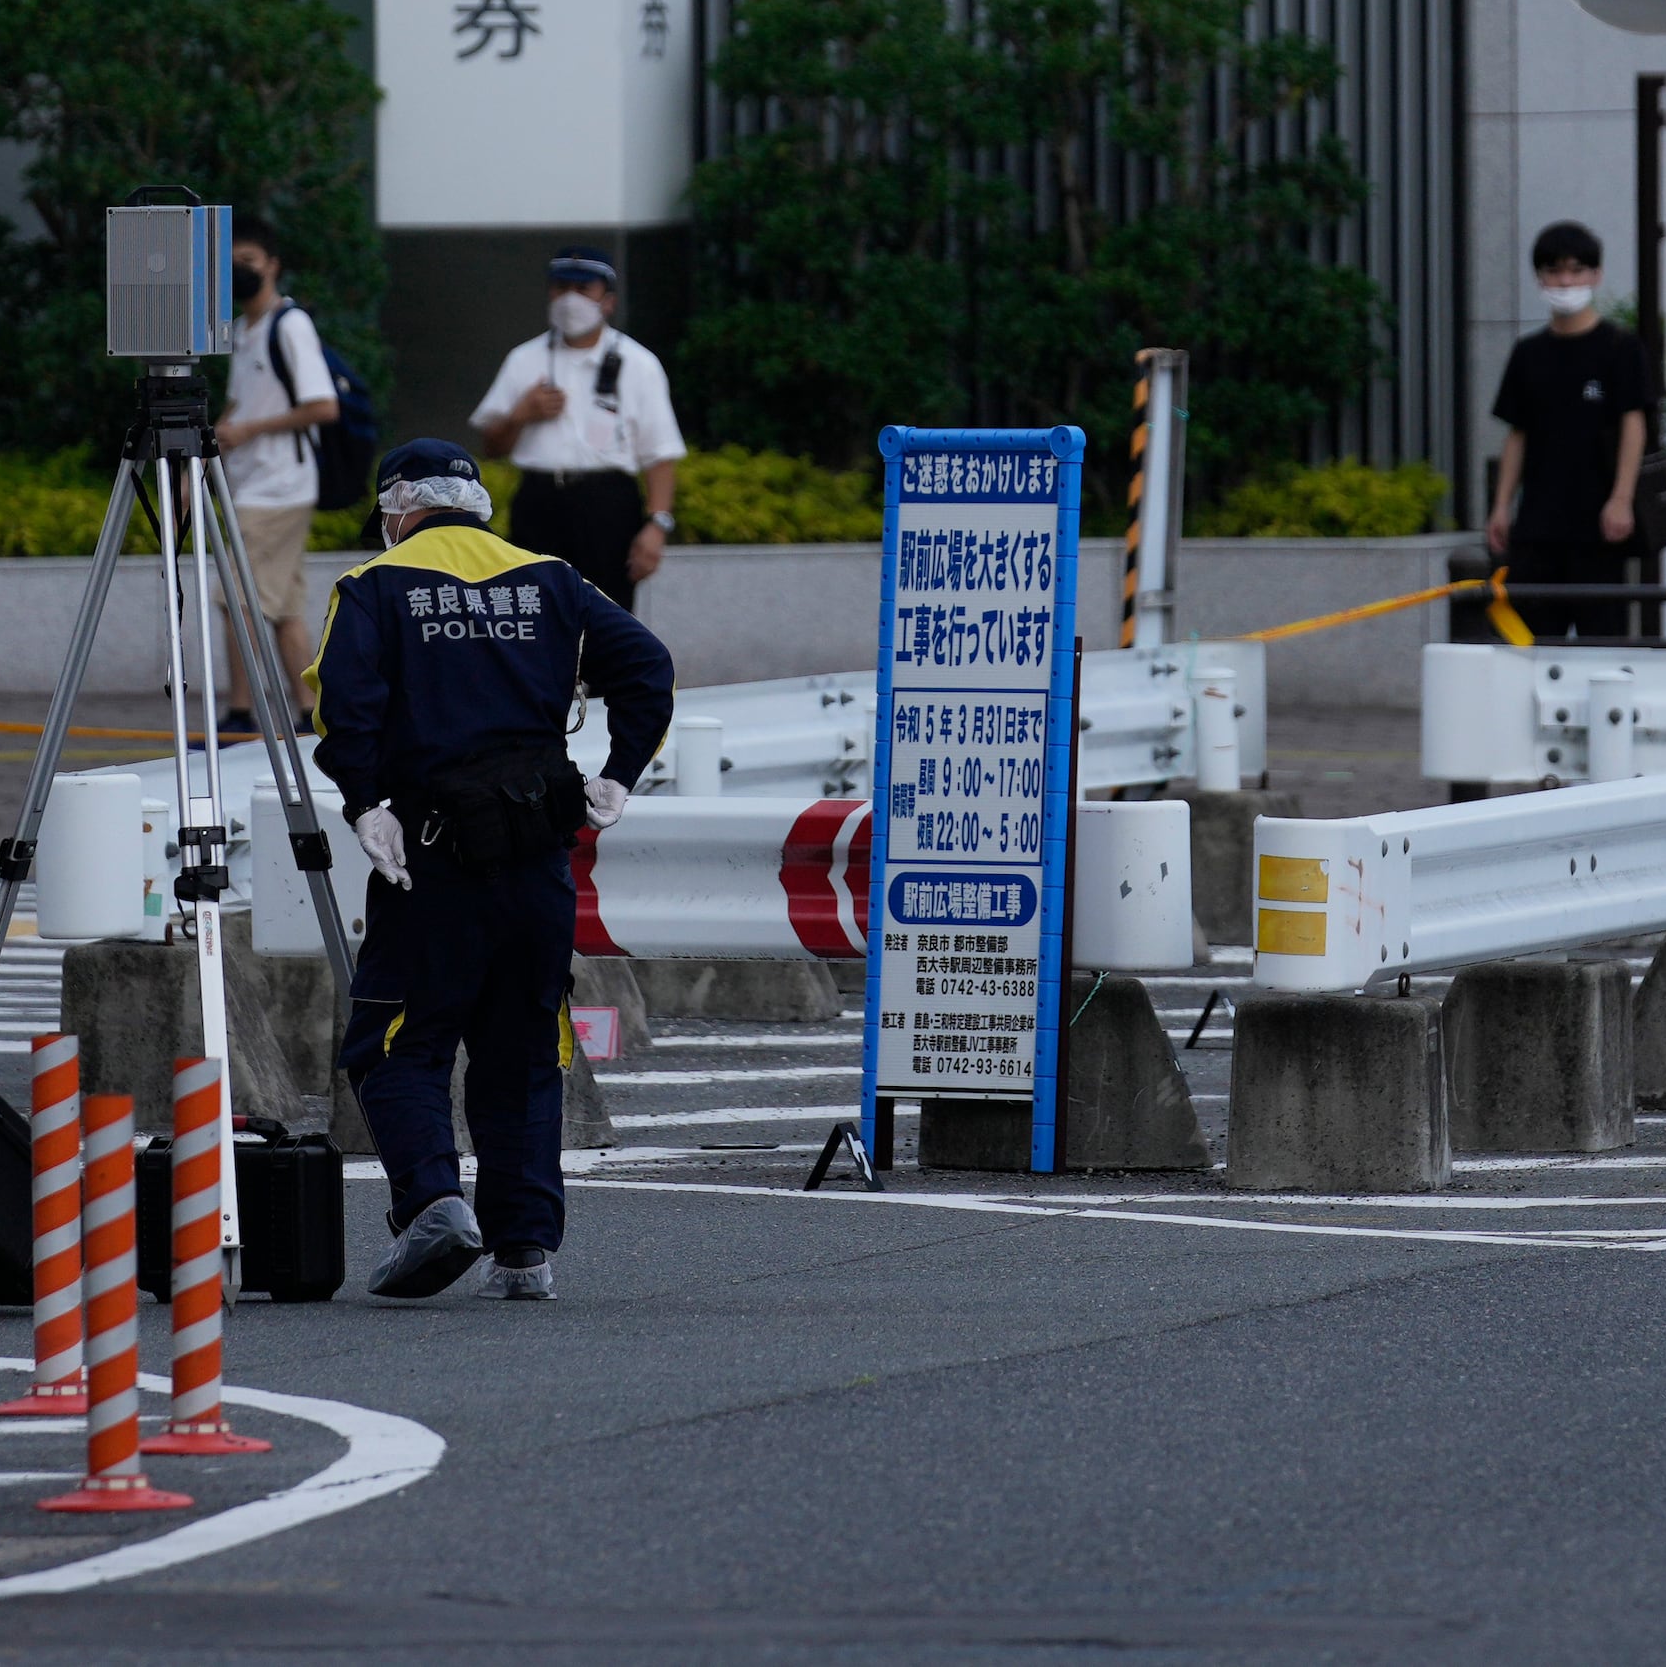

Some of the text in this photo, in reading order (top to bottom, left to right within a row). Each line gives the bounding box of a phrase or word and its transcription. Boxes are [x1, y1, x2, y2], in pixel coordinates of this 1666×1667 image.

[903, 453, 1058, 495] ご迷惑をおかけします
[899, 529, 1052, 593] 駅前広場を大きくする
[406, 583, 542, 618] 奈良県警察
[421, 619, 537, 643] POLICE
[895, 603, 1050, 668] 工事を行っています
[892, 782, 916, 818] 時間帯
[917, 812, 934, 851] 夜間
[902, 881, 1022, 921] 駅前広場整備工事
[884, 933, 1009, 954] 発注者 奈良市 都市整備部
[916, 955, 1038, 976] 西大寺駅周辺整備事務所
[916, 977, 1035, 997] 電話 0742-43-6388
[881, 1011, 906, 1030] 施工者
[912, 1055, 1032, 1077] 電話 0742-93-6614
